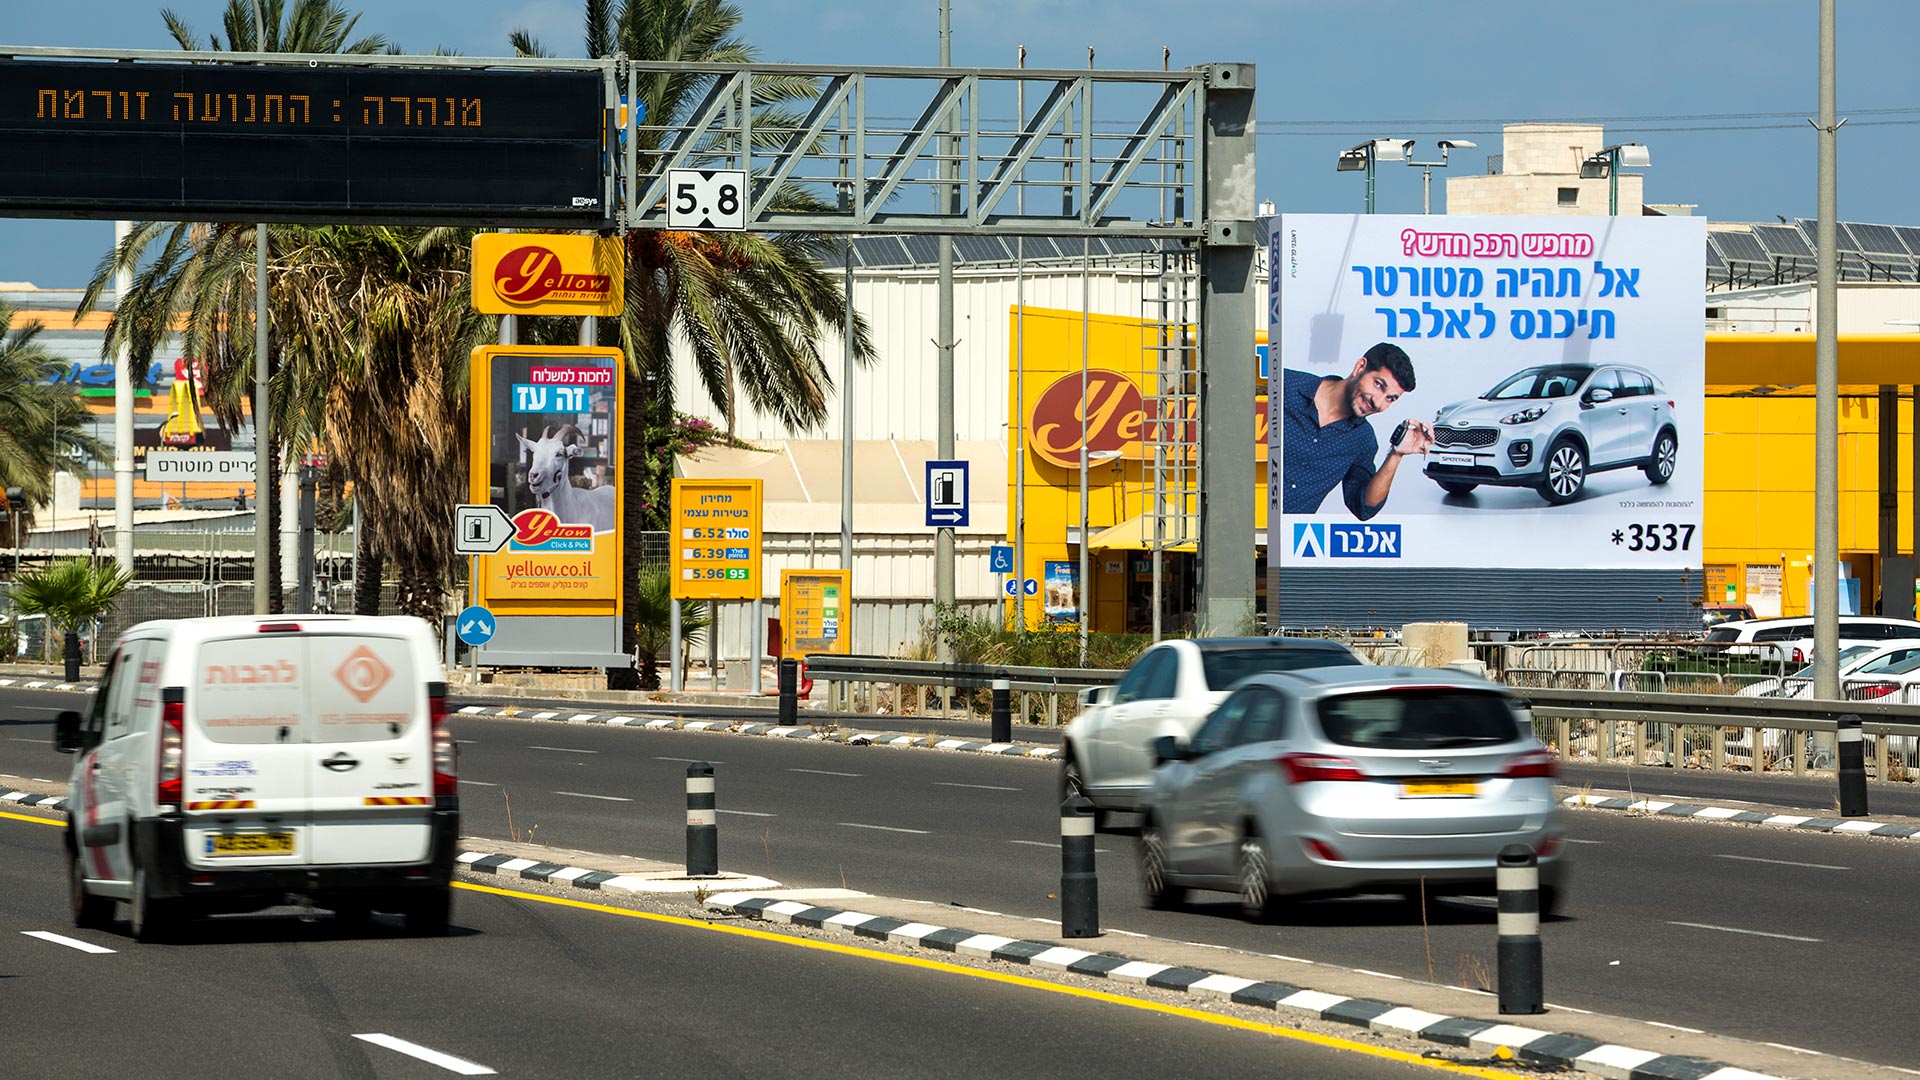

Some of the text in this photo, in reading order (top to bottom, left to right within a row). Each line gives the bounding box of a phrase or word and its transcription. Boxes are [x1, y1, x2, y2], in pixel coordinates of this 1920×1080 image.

[37, 89, 150, 120] זורמת
[173, 92, 310, 123] התנועה
[363, 96, 481, 127] מנהרה
[675, 183, 739, 216] 5.8
[1401, 228, 1593, 257] מחפש רכב חדש?
[1352, 260, 1640, 298] אל תהיה מטורטר
[1375, 302, 1616, 340] תיכנס לאלבר
[532, 367, 611, 383] לחכות למשלוח
[517, 386, 585, 411] זה עז
[158, 460, 213, 473] מוטורס
[701, 494, 732, 505] מחירון
[684, 509, 749, 518] בשירות עצמי
[693, 528, 749, 538] סולר 6.52
[1335, 526, 1396, 553] אלבר
[551, 541, 567, 549] Click
[575, 541, 589, 549] Pick
[693, 547, 725, 559] 6.39
[506, 560, 592, 580] yellow.co.il
[693, 568, 746, 579] 95 5.96
